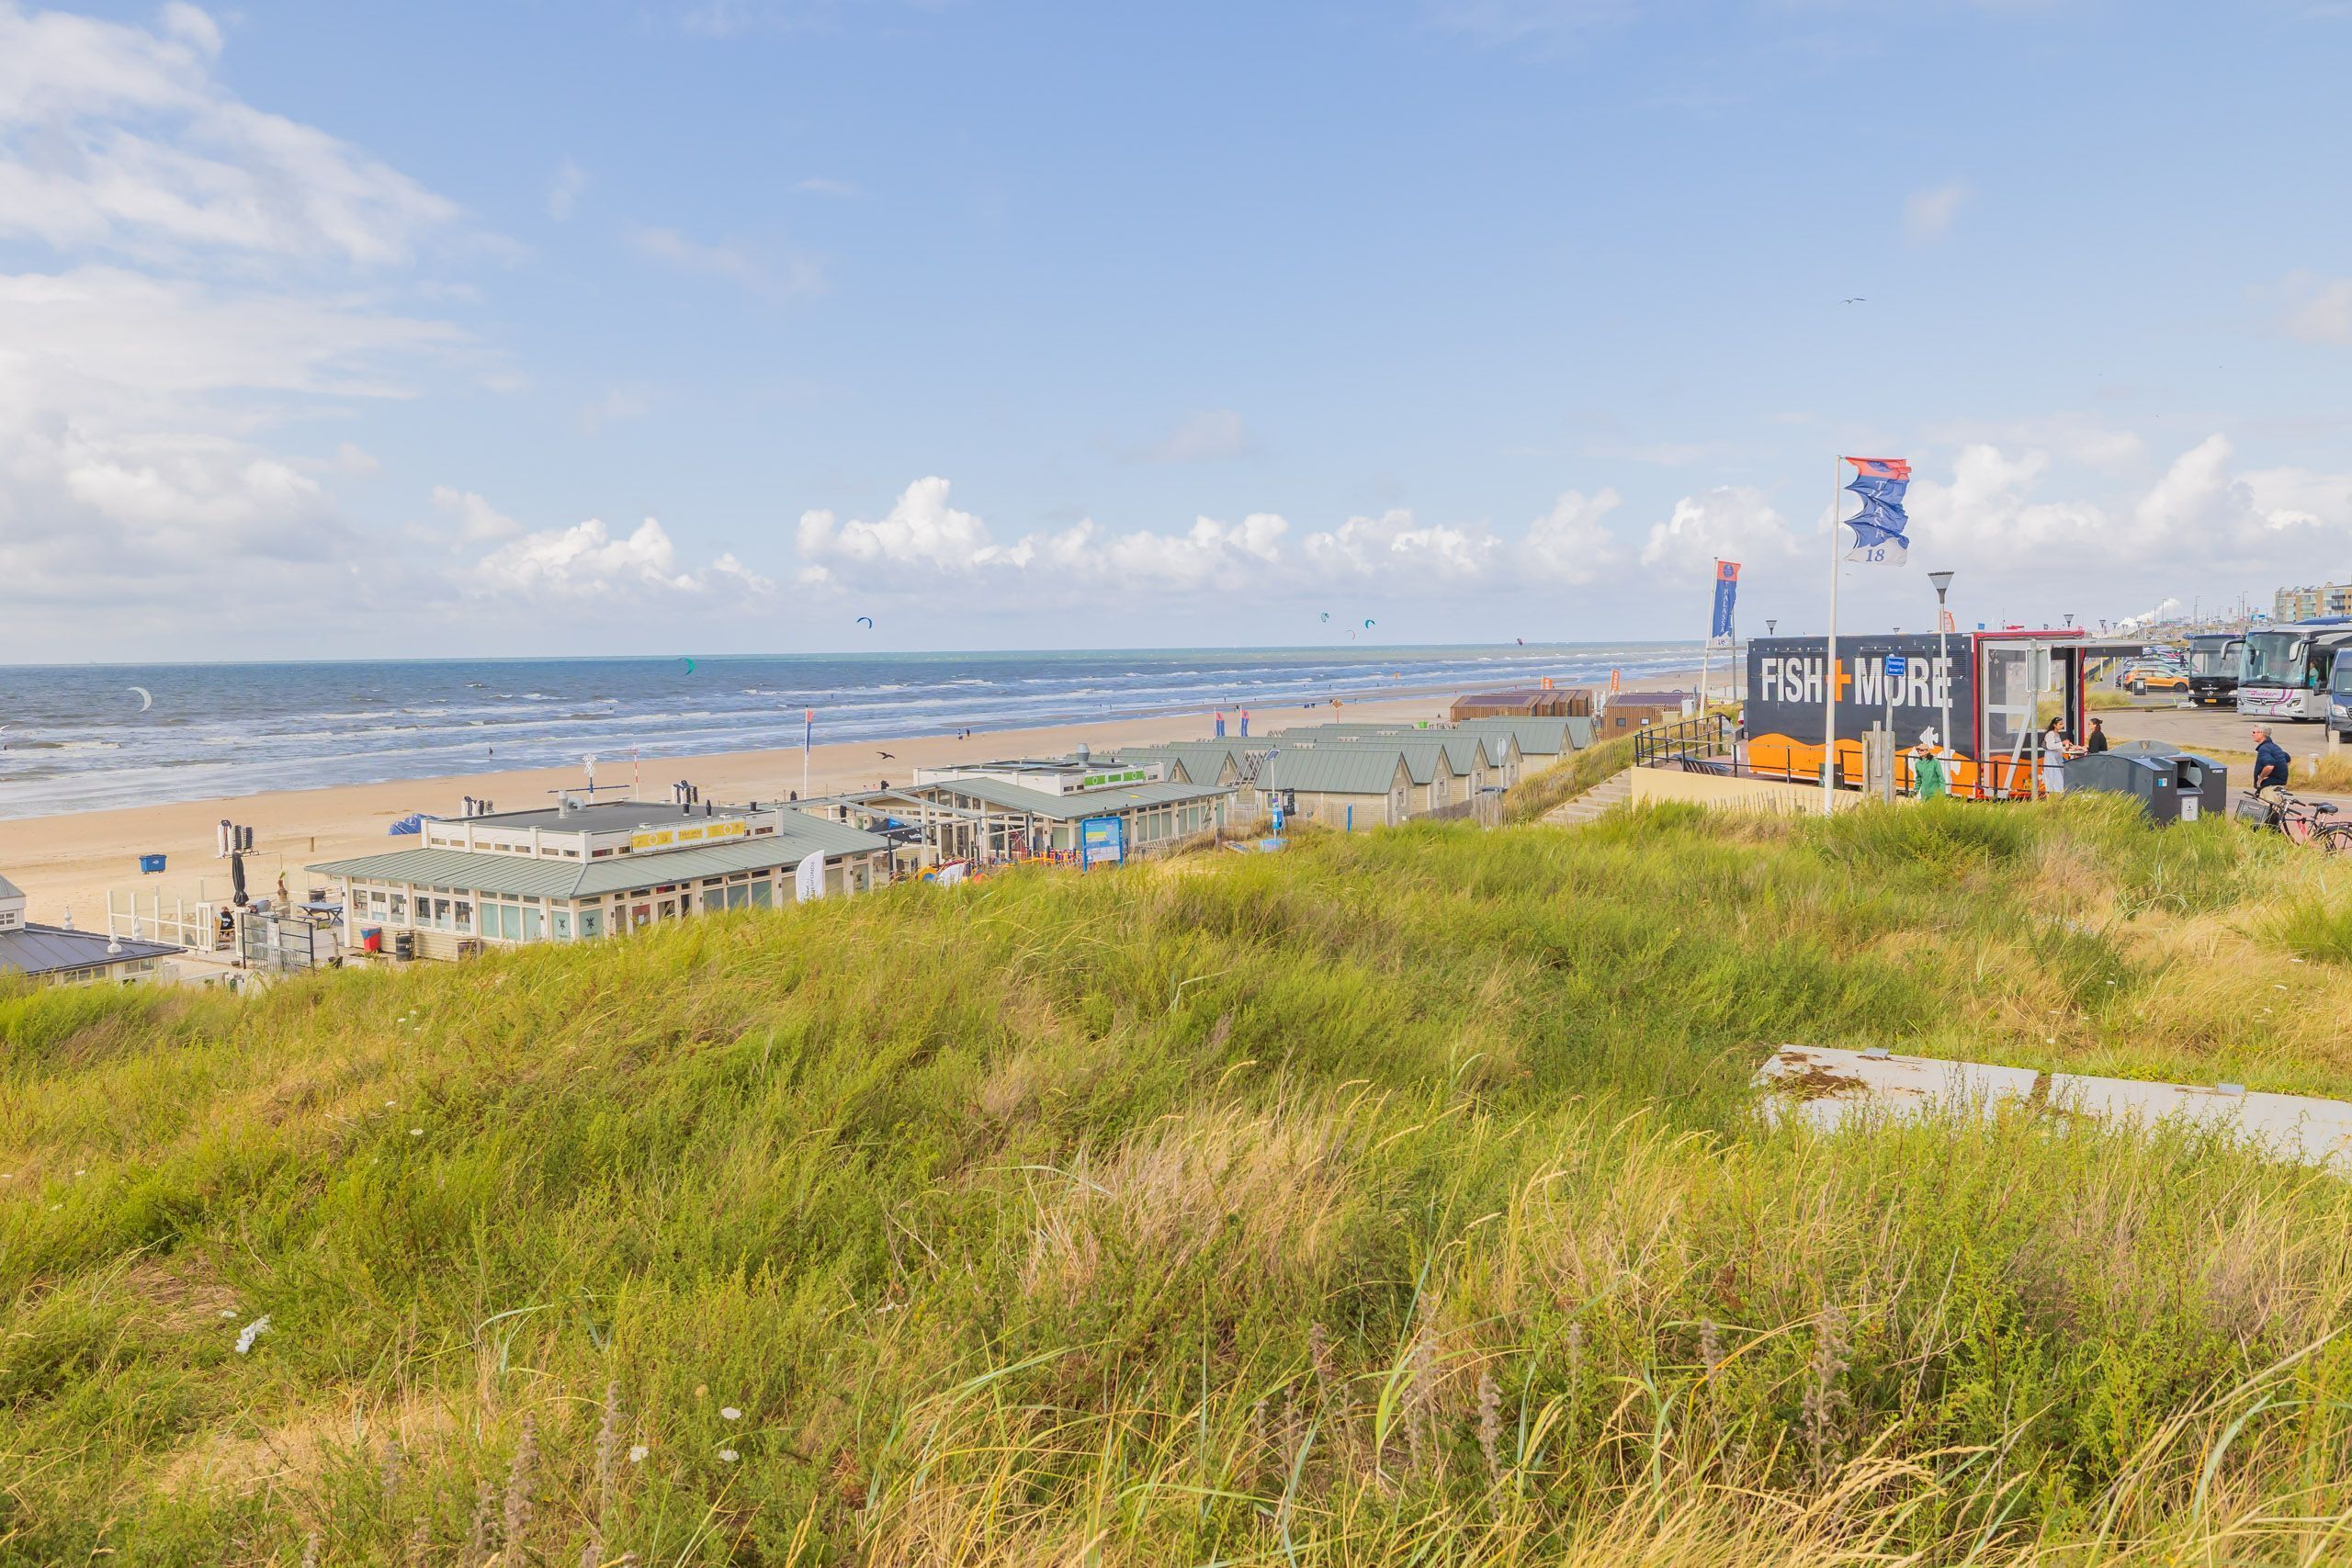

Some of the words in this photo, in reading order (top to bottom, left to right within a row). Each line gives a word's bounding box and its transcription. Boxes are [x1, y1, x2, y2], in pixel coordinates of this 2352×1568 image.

[1865, 548, 1885, 562] 18
[1721, 581, 1729, 633] HALASSA
[1761, 657, 1823, 704] FISH
